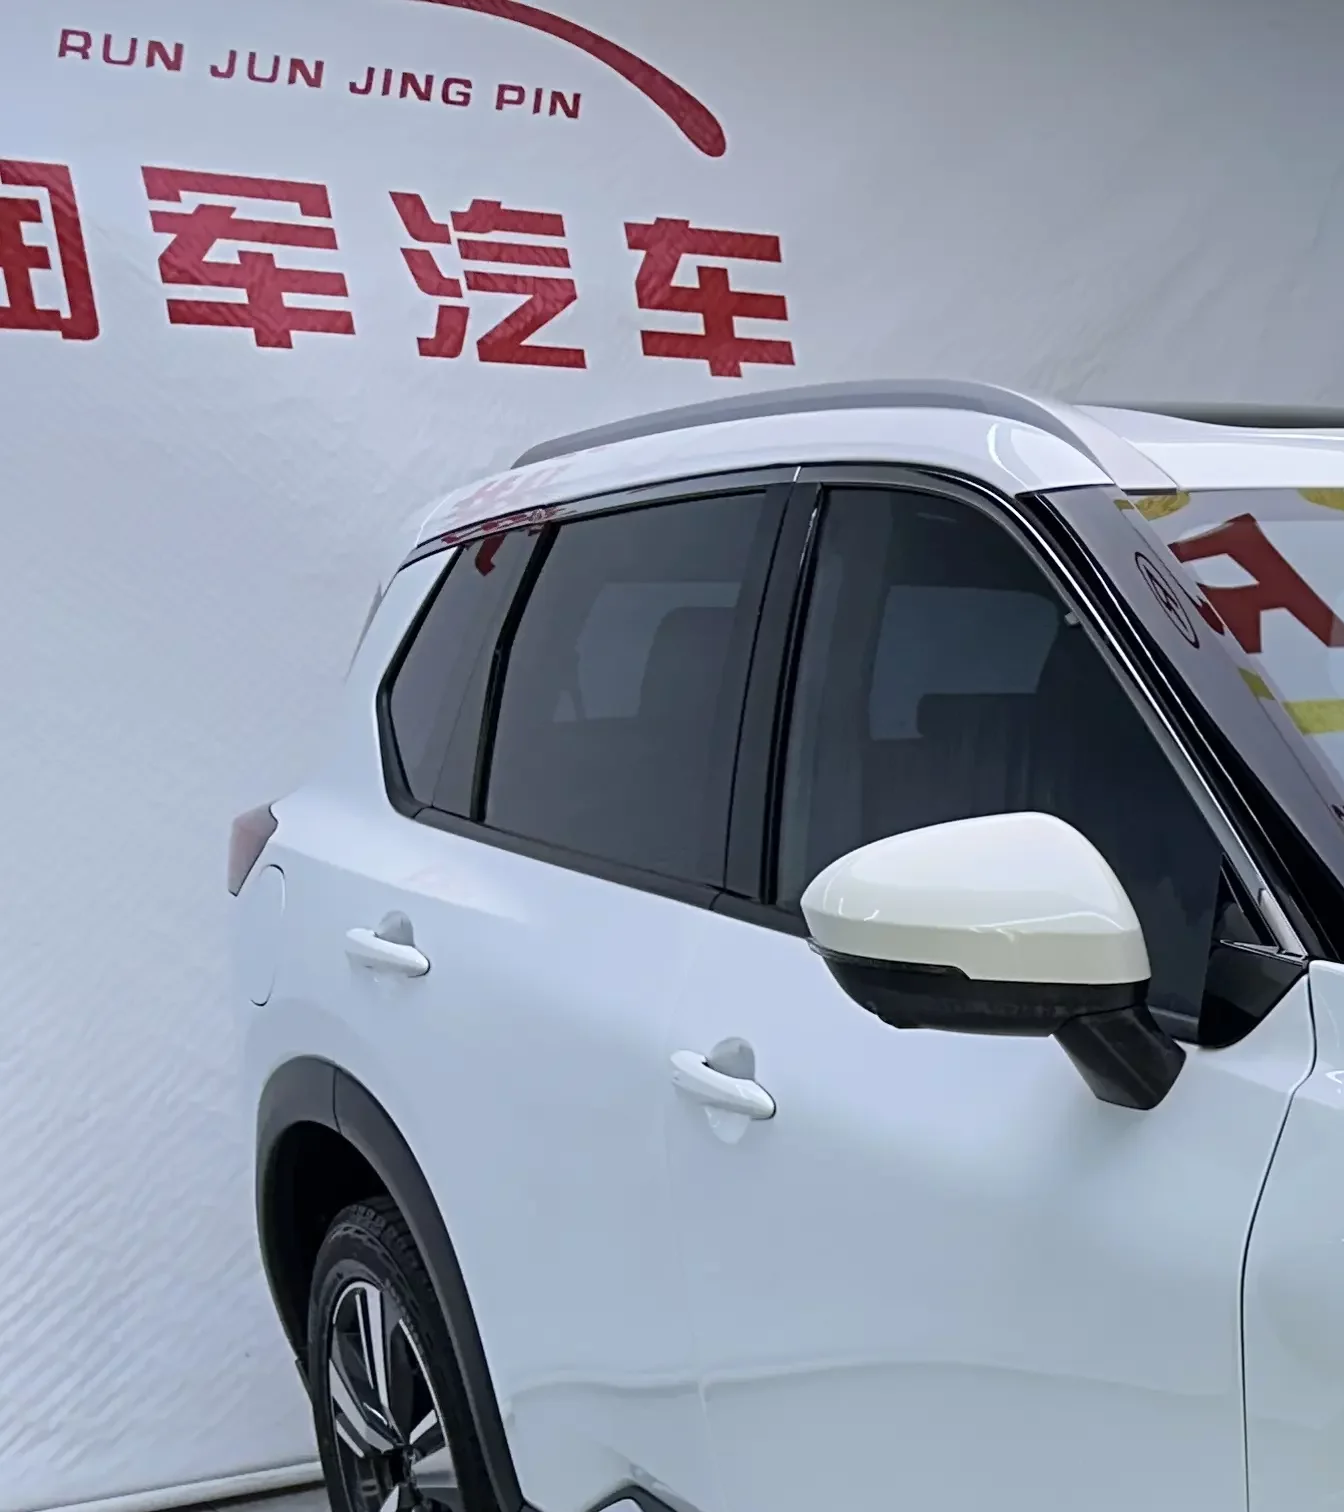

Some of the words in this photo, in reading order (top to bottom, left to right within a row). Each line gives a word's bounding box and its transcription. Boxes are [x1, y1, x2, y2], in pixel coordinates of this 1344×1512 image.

[57, 28, 185, 72] RUN
[209, 49, 325, 90] JUN
[349, 65, 473, 109] JING
[495, 83, 583, 120] PIN
